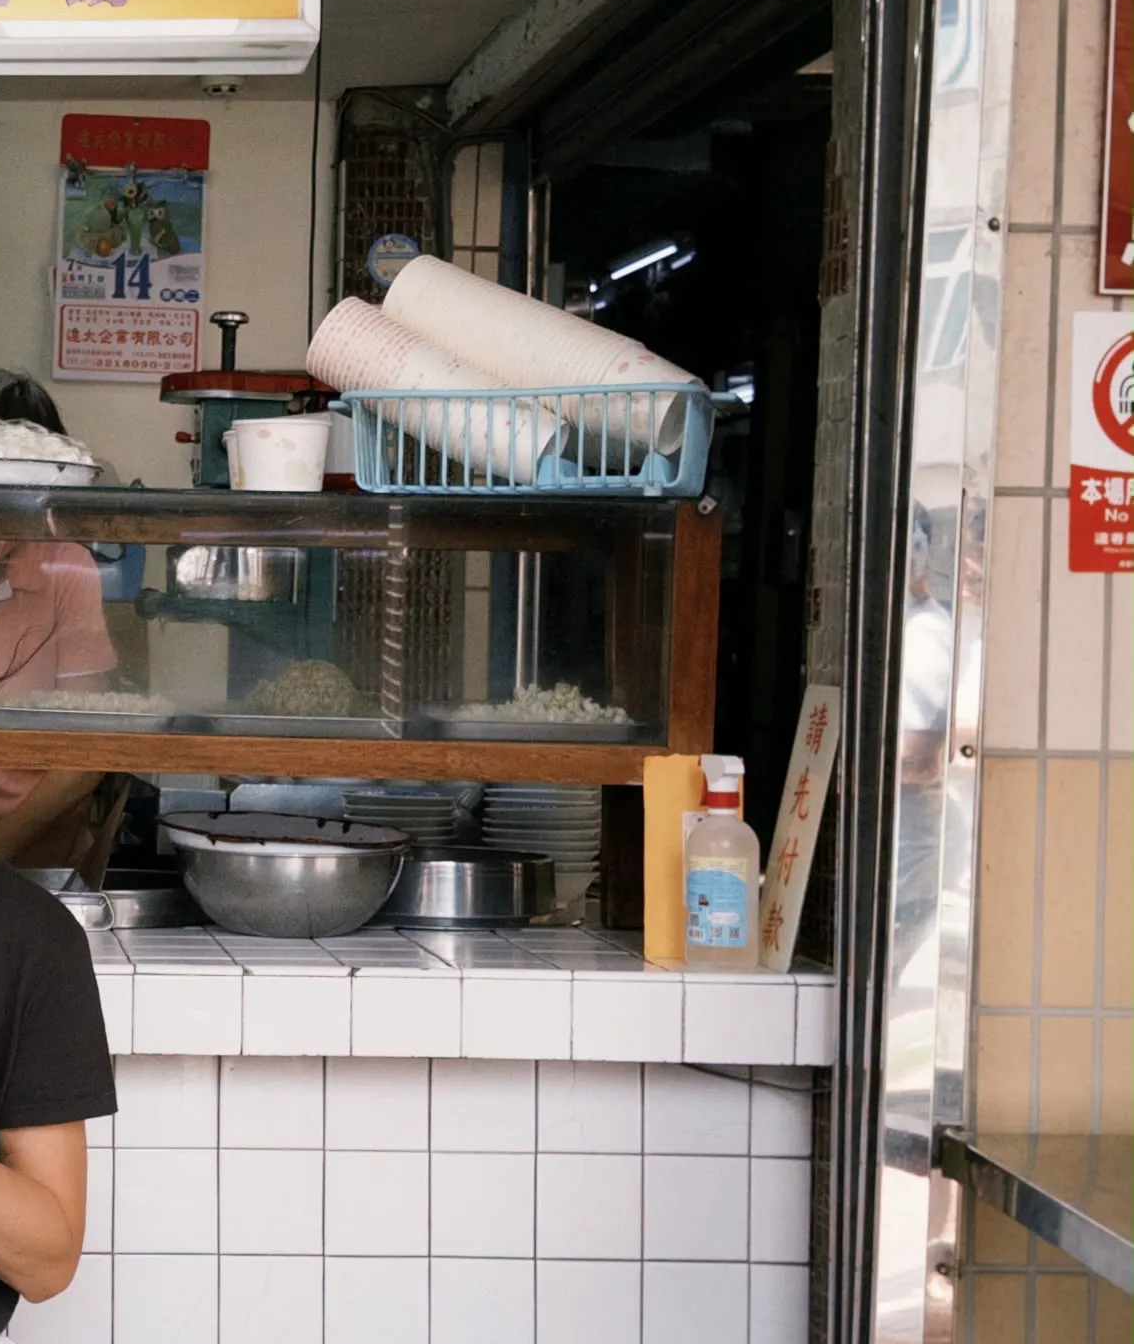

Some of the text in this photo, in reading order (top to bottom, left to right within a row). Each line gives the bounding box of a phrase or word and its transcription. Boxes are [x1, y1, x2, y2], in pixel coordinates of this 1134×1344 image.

[111, 253, 153, 300] 14
[1104, 507, 1129, 523] No
[762, 703, 828, 952] 請先付款
